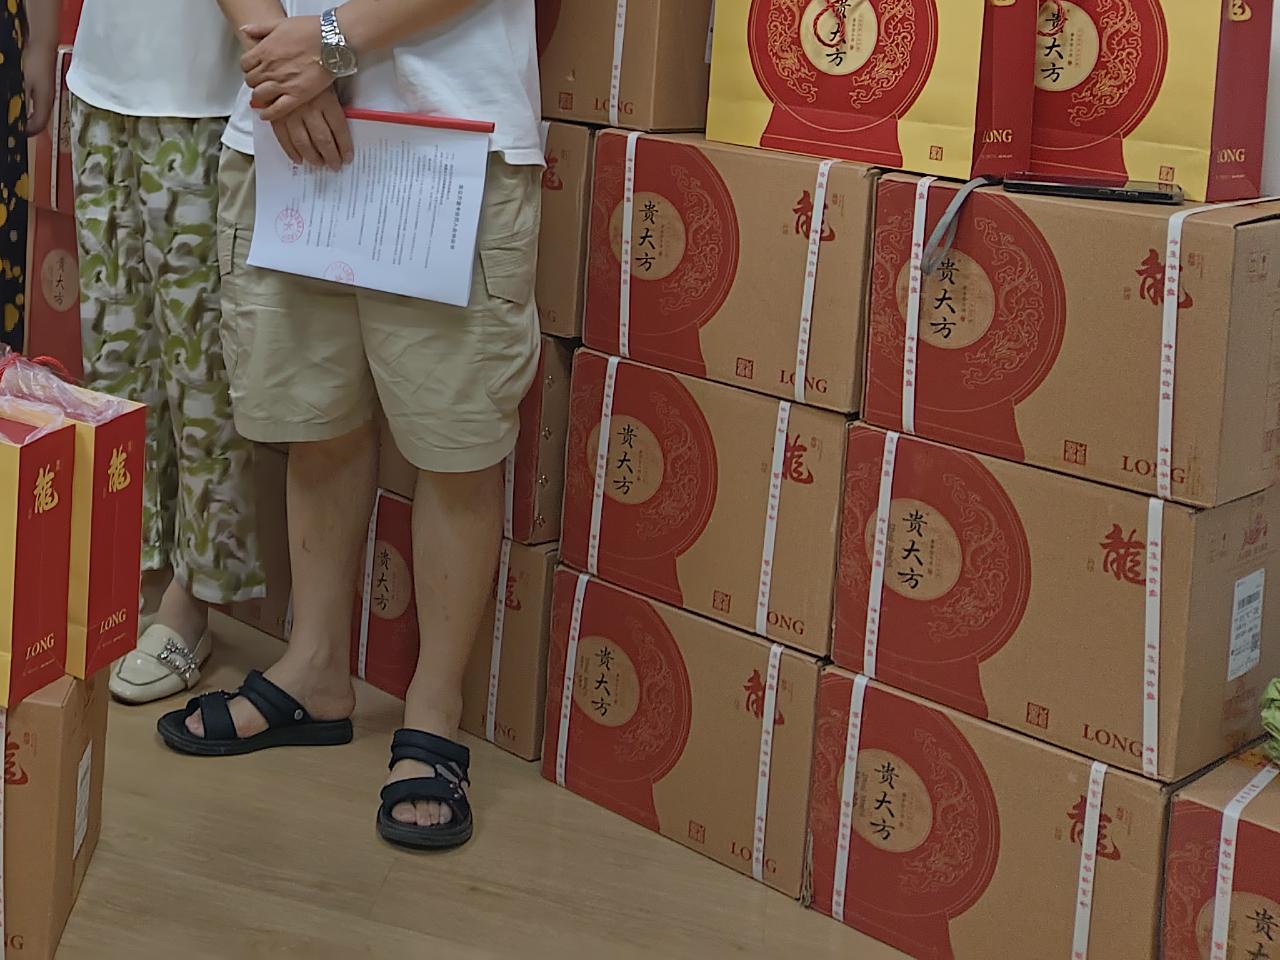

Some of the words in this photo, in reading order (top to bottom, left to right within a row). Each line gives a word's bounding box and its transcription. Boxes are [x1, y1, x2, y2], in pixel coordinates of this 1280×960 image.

[635, 200, 659, 273] 贵大方
[929, 258, 961, 339] 贵大方
[33, 463, 59, 514] 龍
[107, 443, 131, 493] 龍
[613, 424, 638, 495] 贵大方
[374, 548, 392, 611] 贵大方
[897, 509, 928, 590] 贵大方
[25, 633, 55, 661] LONG
[100, 608, 127, 634] LONG
[767, 611, 805, 636] ONG
[592, 645, 616, 717] 贵大方
[870, 761, 900, 841] 贵大方
[730, 841, 777, 874] LOG
